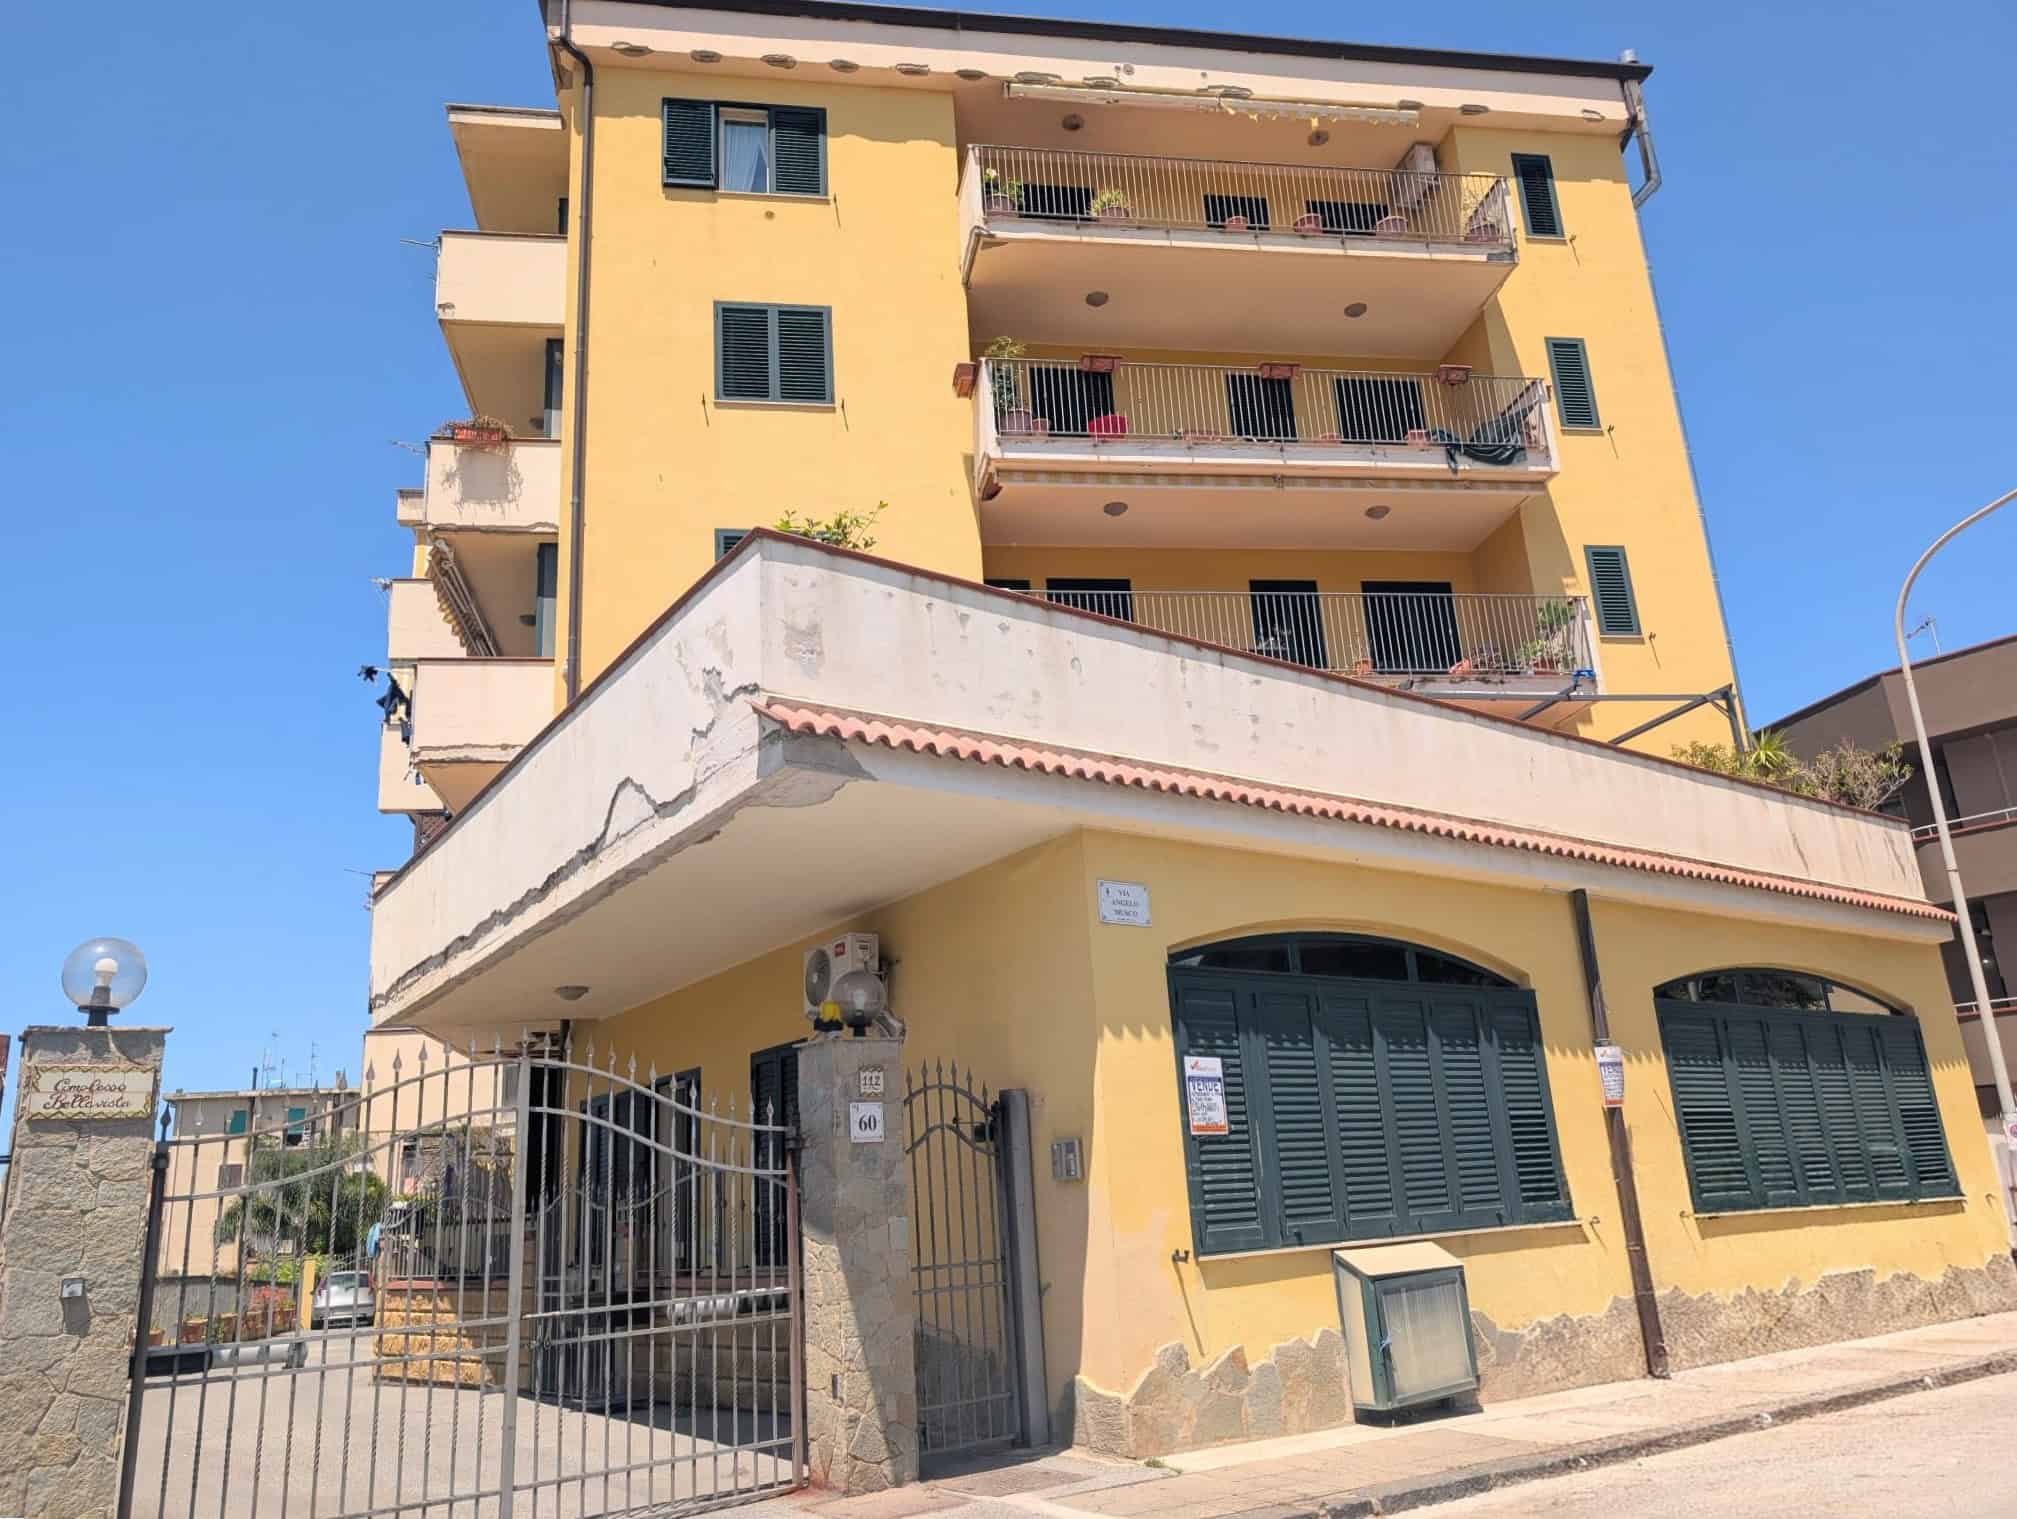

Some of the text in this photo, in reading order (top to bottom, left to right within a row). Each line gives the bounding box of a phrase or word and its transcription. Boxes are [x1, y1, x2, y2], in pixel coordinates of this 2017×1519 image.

[1118, 888, 1130, 897] VIA
[1112, 898, 1138, 907] ANGELO
[858, 1114, 877, 1131] 60
